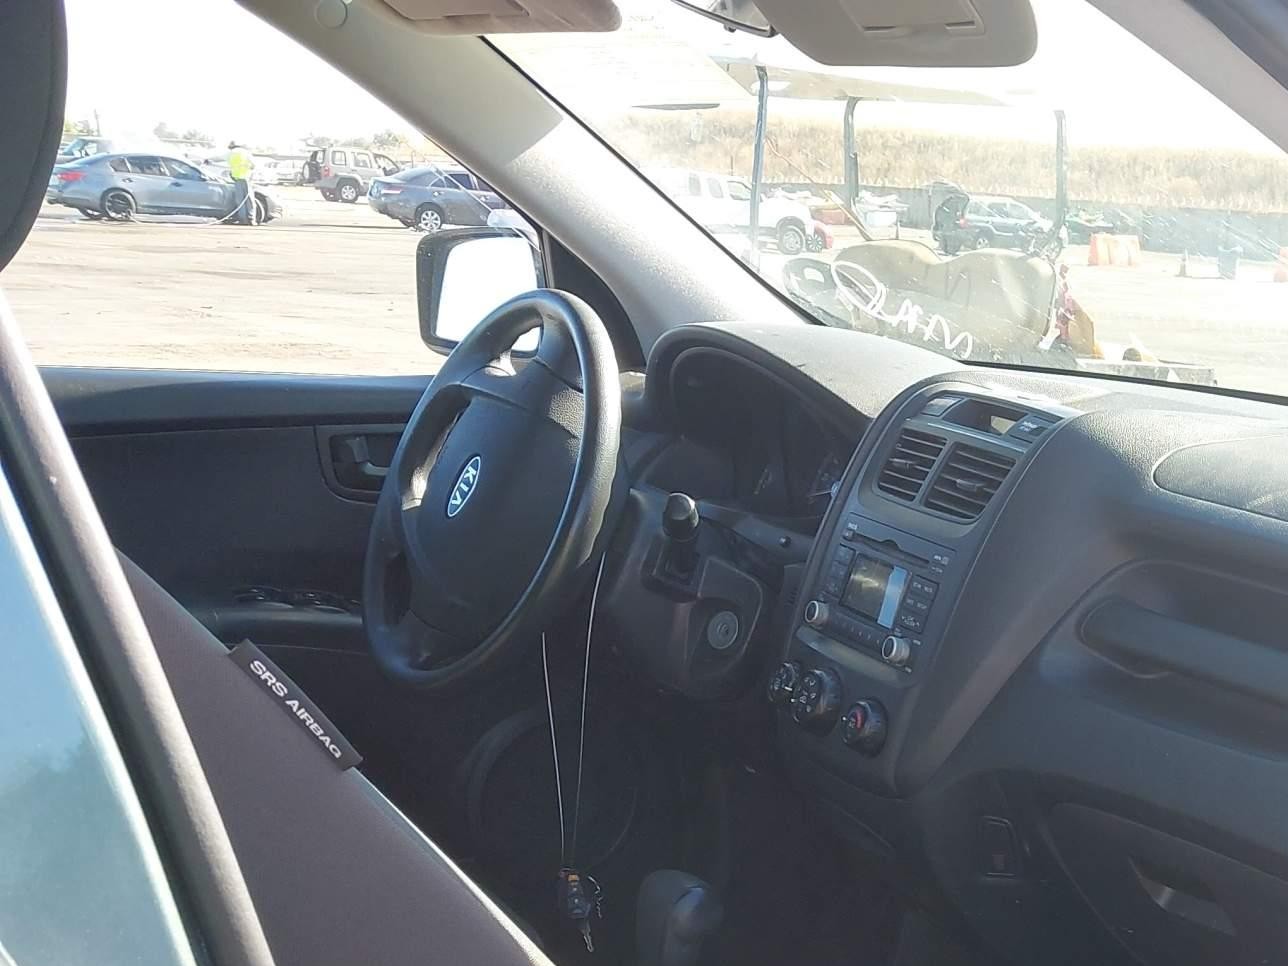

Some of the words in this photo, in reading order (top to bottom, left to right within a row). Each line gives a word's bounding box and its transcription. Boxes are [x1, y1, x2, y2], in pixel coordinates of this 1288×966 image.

[451, 465, 477, 505] KIA
[249, 659, 289, 698] SRS
[285, 698, 342, 759] AIRBAG
